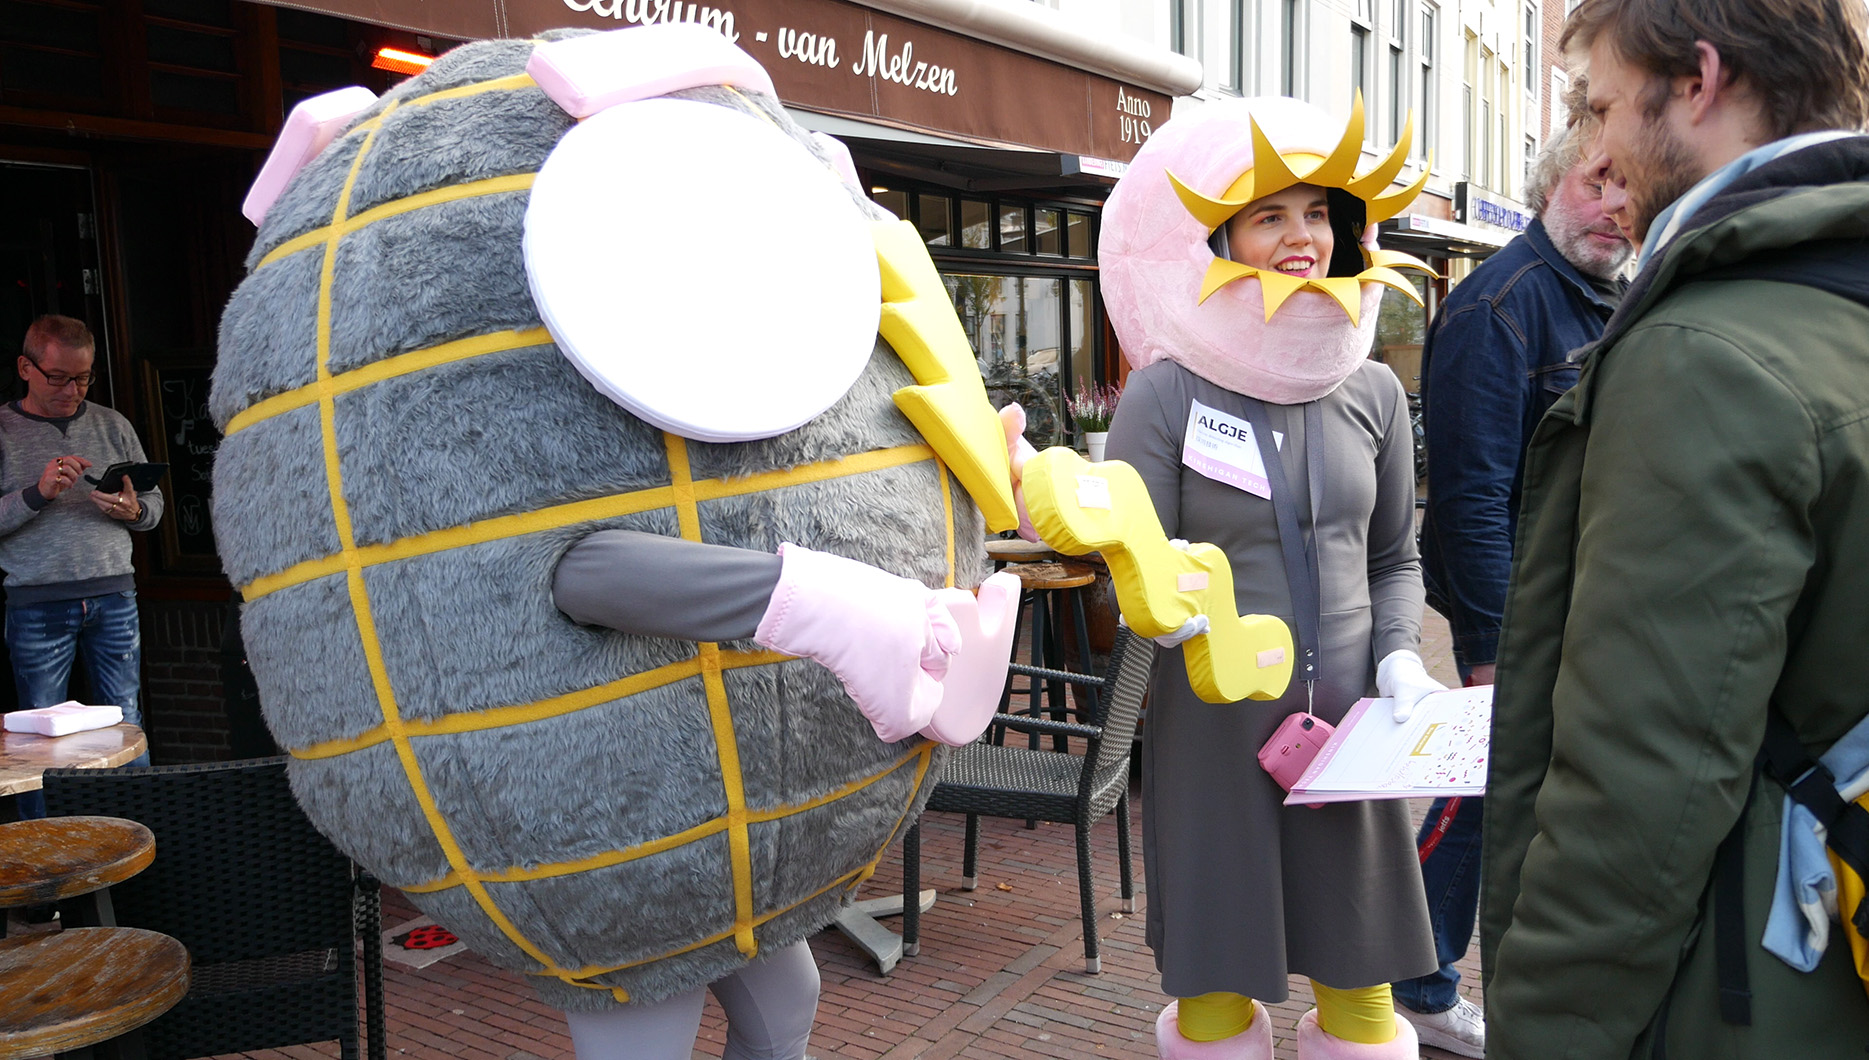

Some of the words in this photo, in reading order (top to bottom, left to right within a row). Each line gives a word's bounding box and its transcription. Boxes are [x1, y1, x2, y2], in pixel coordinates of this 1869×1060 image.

[778, 27, 840, 69] van
[853, 30, 958, 96] Melzen
[1116, 86, 1151, 118] Anno
[1120, 115, 1151, 144] 1919
[1197, 415, 1248, 443] ALGJE
[1241, 477, 1266, 492] TECH
